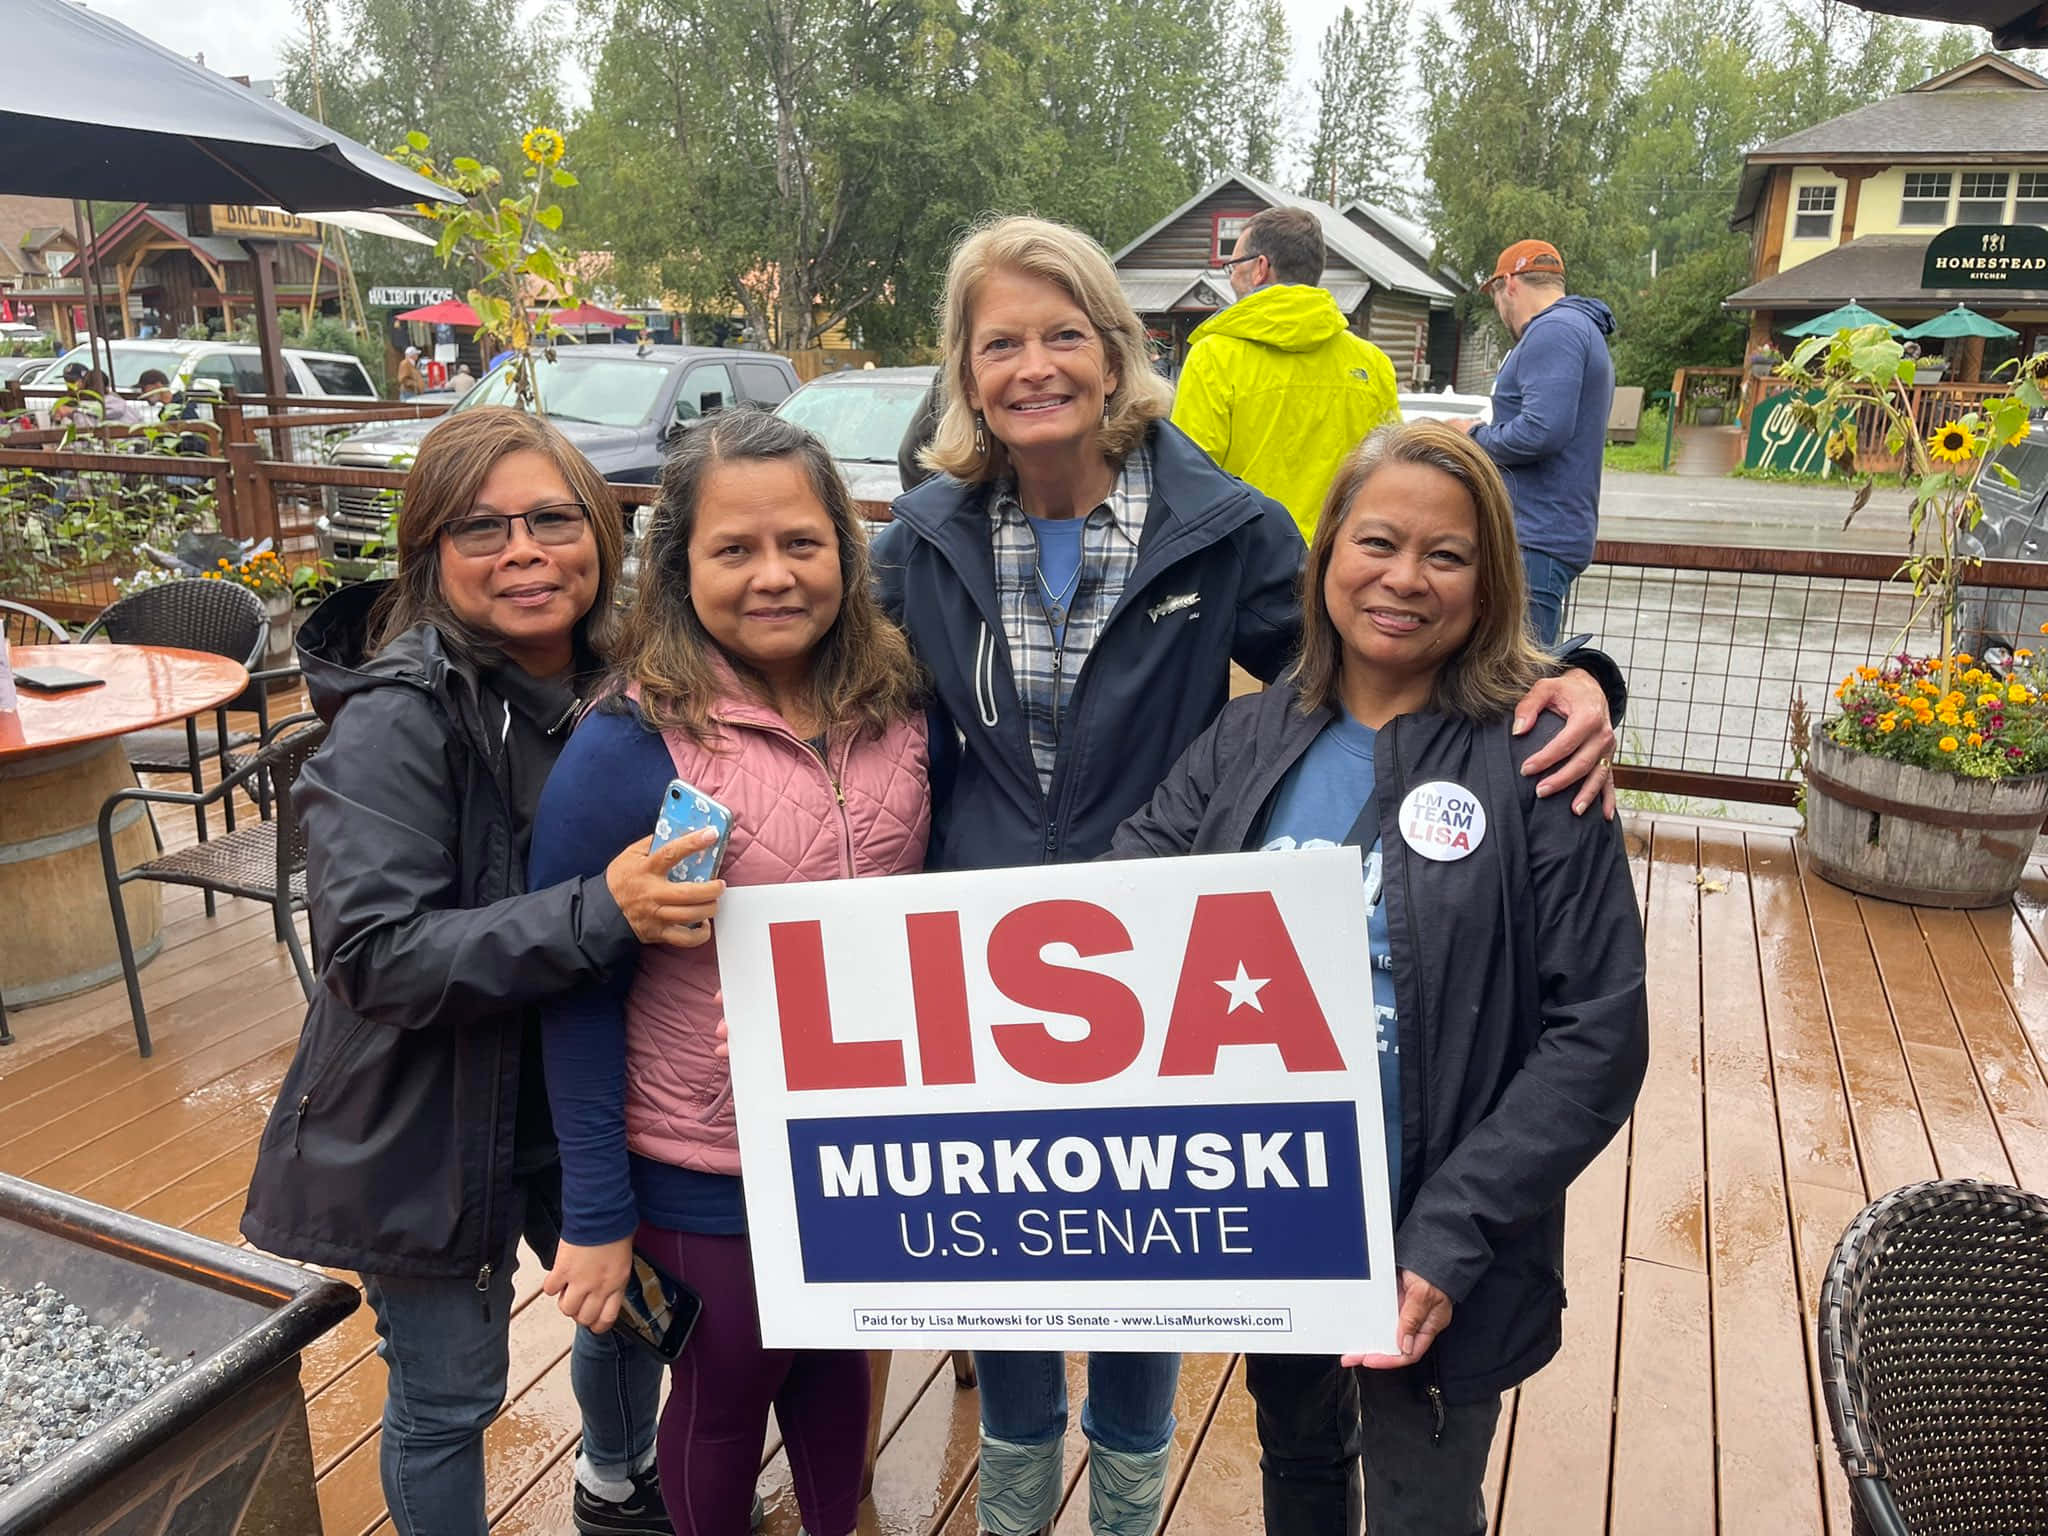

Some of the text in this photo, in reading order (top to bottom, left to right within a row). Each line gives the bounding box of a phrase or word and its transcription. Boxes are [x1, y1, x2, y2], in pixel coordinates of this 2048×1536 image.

[1935, 257, 2046, 269] HOMESTEAD
[1970, 272, 2007, 280] KITCHEN
[369, 287, 416, 305] HALIBUT
[1414, 791, 1475, 815] I'M ON
[1412, 803, 1473, 830] TEAM
[1408, 820, 1470, 851] LISA
[769, 891, 1347, 1091] LISA
[818, 1131, 1329, 1198] MURKOWSKI
[900, 1207, 1253, 1258] U.S. SENATE
[862, 1315, 888, 1326] Paid
[891, 1315, 908, 1326] for
[911, 1315, 926, 1329] by
[929, 1315, 954, 1326] Lisa
[957, 1315, 1022, 1326] Murkowski
[1025, 1314, 1043, 1326] for
[1046, 1314, 1064, 1326] US
[1067, 1314, 1110, 1326] Senate
[1121, 1314, 1284, 1327] www.LisaMurkowski.com
